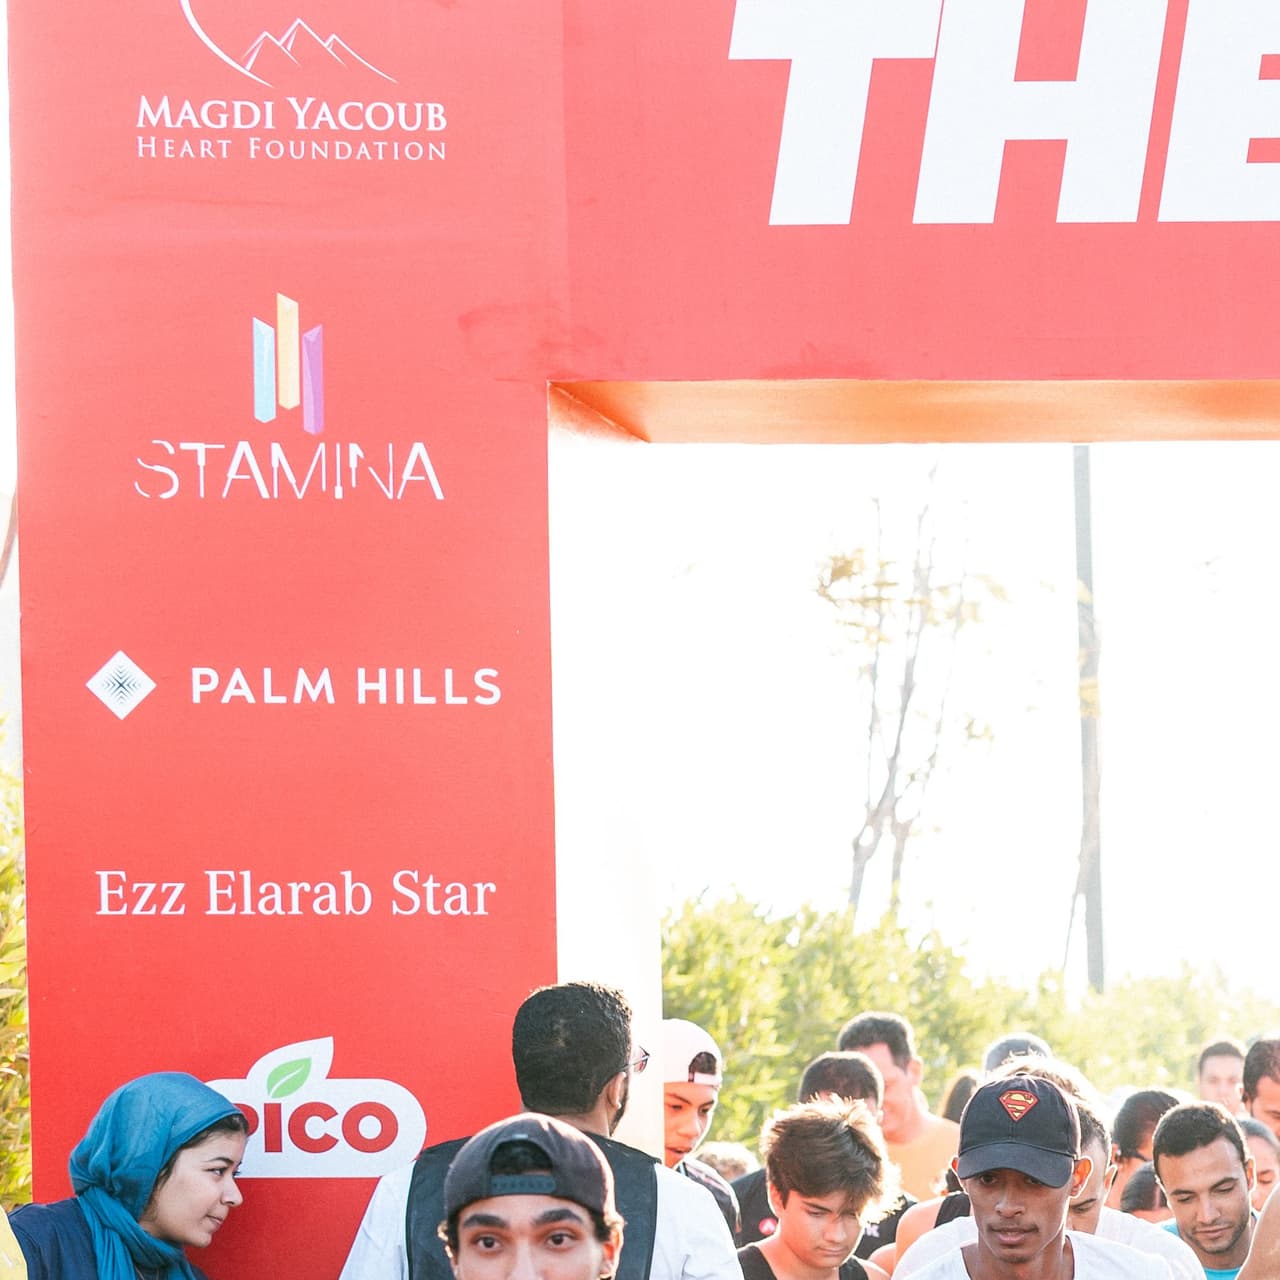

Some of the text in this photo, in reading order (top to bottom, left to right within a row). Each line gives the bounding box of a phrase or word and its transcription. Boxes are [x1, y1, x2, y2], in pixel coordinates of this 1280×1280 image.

[136, 96, 447, 131] MAGDI YACOUB
[137, 137, 447, 161] HEART FOUNDATION
[134, 440, 444, 499] STAMINA
[191, 668, 502, 706] PALM HILLS
[95, 870, 498, 917] Ezz Elarab Star
